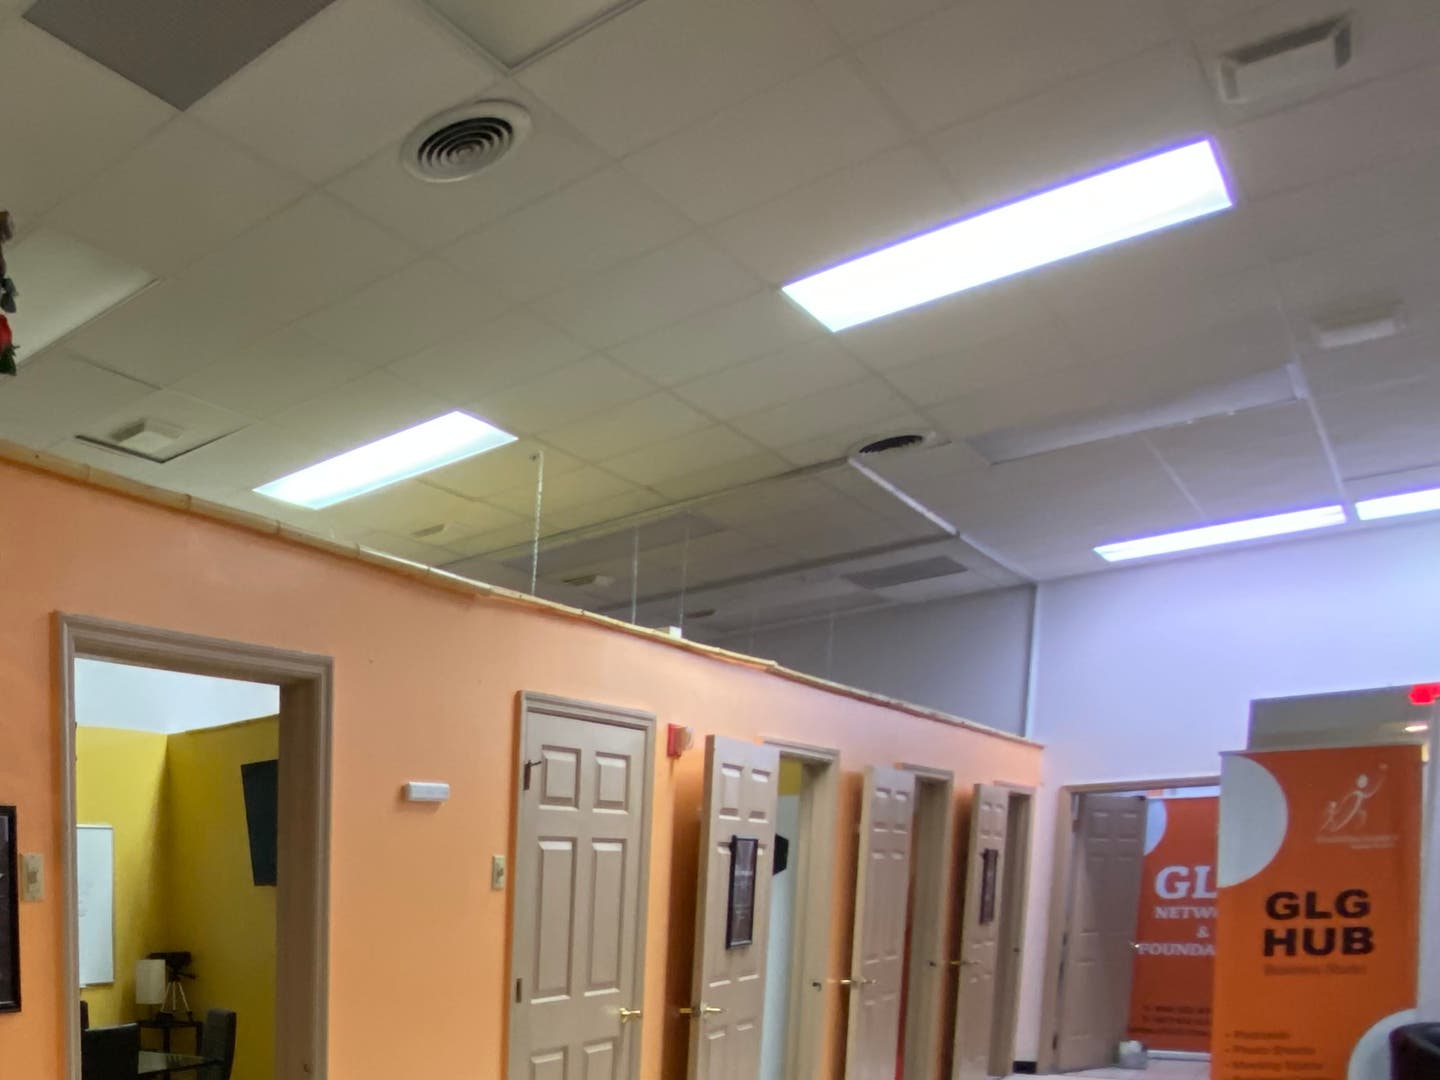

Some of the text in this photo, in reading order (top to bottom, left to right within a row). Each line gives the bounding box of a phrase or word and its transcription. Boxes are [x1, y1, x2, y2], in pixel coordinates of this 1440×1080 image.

[1266, 889, 1371, 920] GLG
[1197, 926, 1209, 938] &
[1263, 926, 1375, 957] HUB
